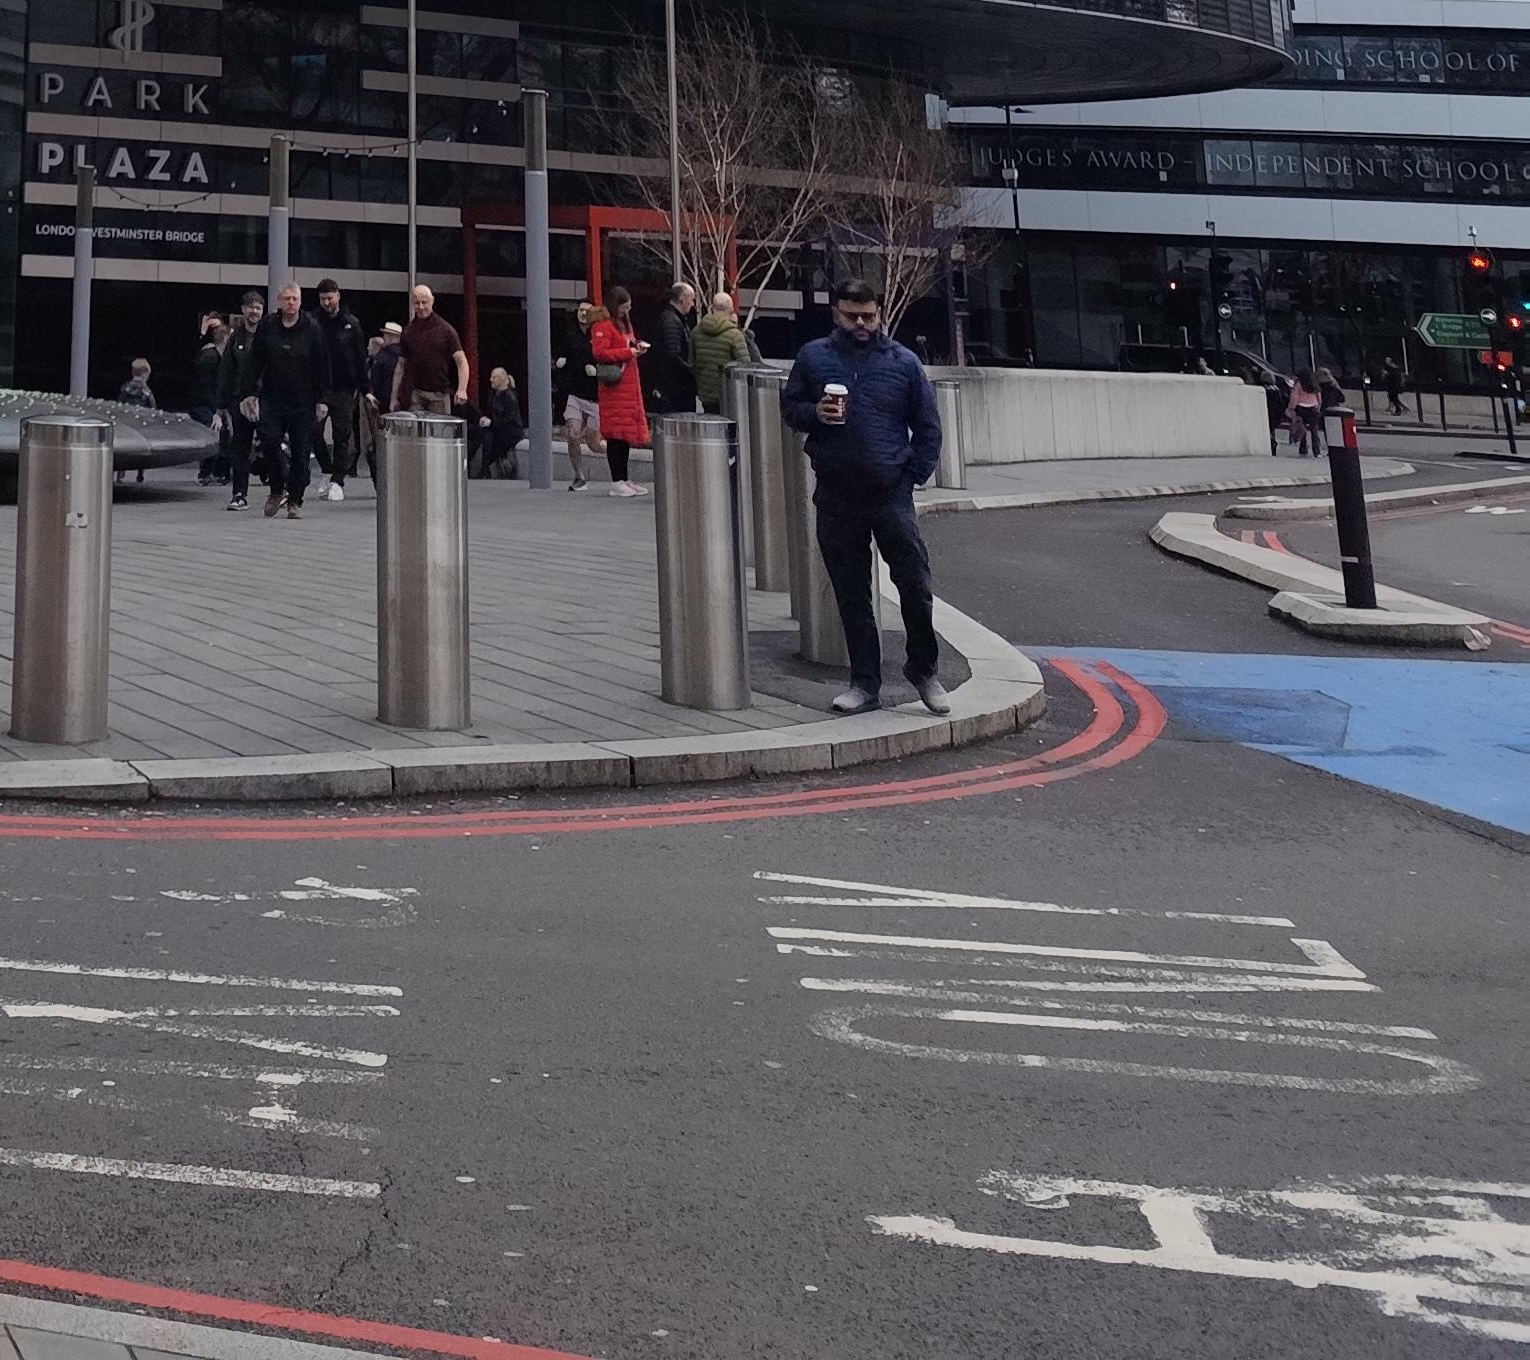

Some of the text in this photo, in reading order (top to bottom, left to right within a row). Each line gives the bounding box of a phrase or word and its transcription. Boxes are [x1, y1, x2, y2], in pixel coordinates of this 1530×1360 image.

[1366, 50, 1478, 71] SCHOOL
[1487, 53, 1519, 73] OF
[40, 72, 210, 115] PARK
[38, 142, 210, 184] PLAZA
[1087, 150, 1175, 170] AWARD
[1207, 153, 1392, 177] INDEPENDENT
[1403, 159, 1515, 182] SCHOOL
[35, 224, 75, 237] LONDO
[165, 231, 205, 243] BRIDGE
[752, 870, 1480, 1095] ONLY
